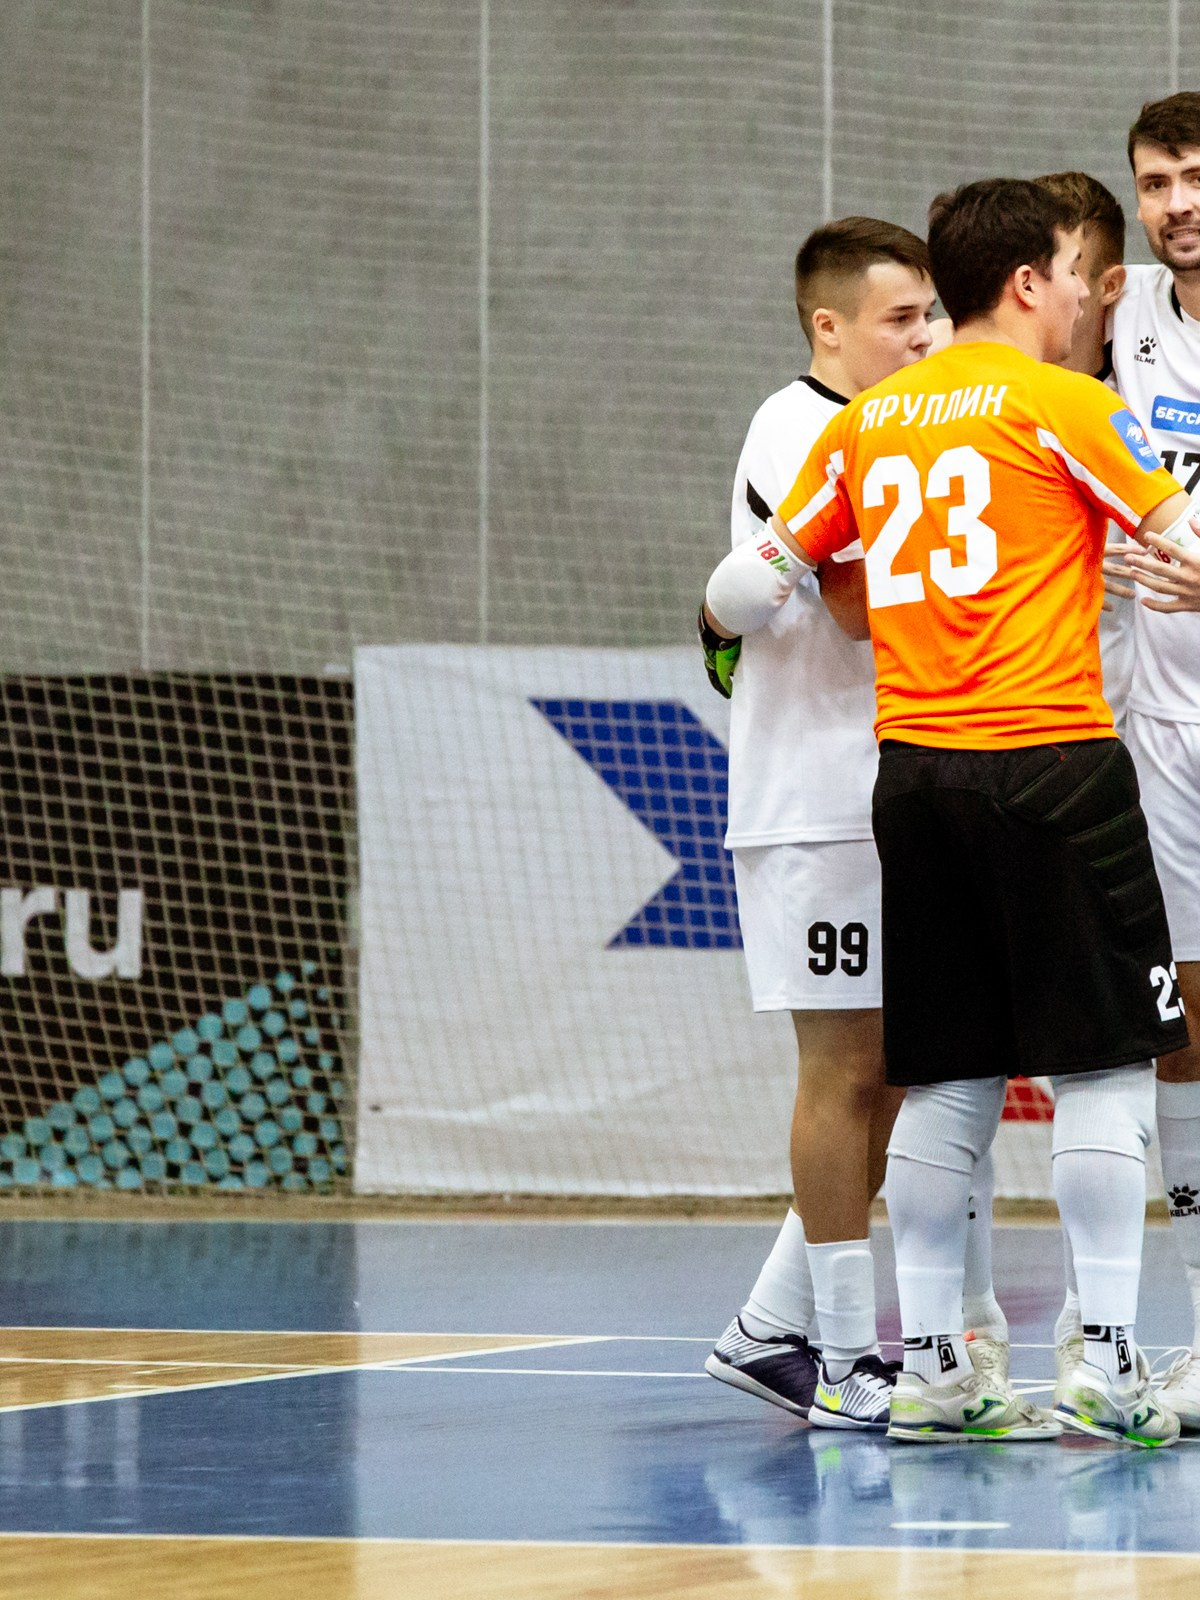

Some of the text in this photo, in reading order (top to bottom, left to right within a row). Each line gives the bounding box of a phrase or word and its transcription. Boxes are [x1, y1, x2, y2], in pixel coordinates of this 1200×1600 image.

[859, 384, 1008, 433] ЯРУЛЛИН
[862, 445, 998, 610] 23
[807, 921, 869, 977] 99
